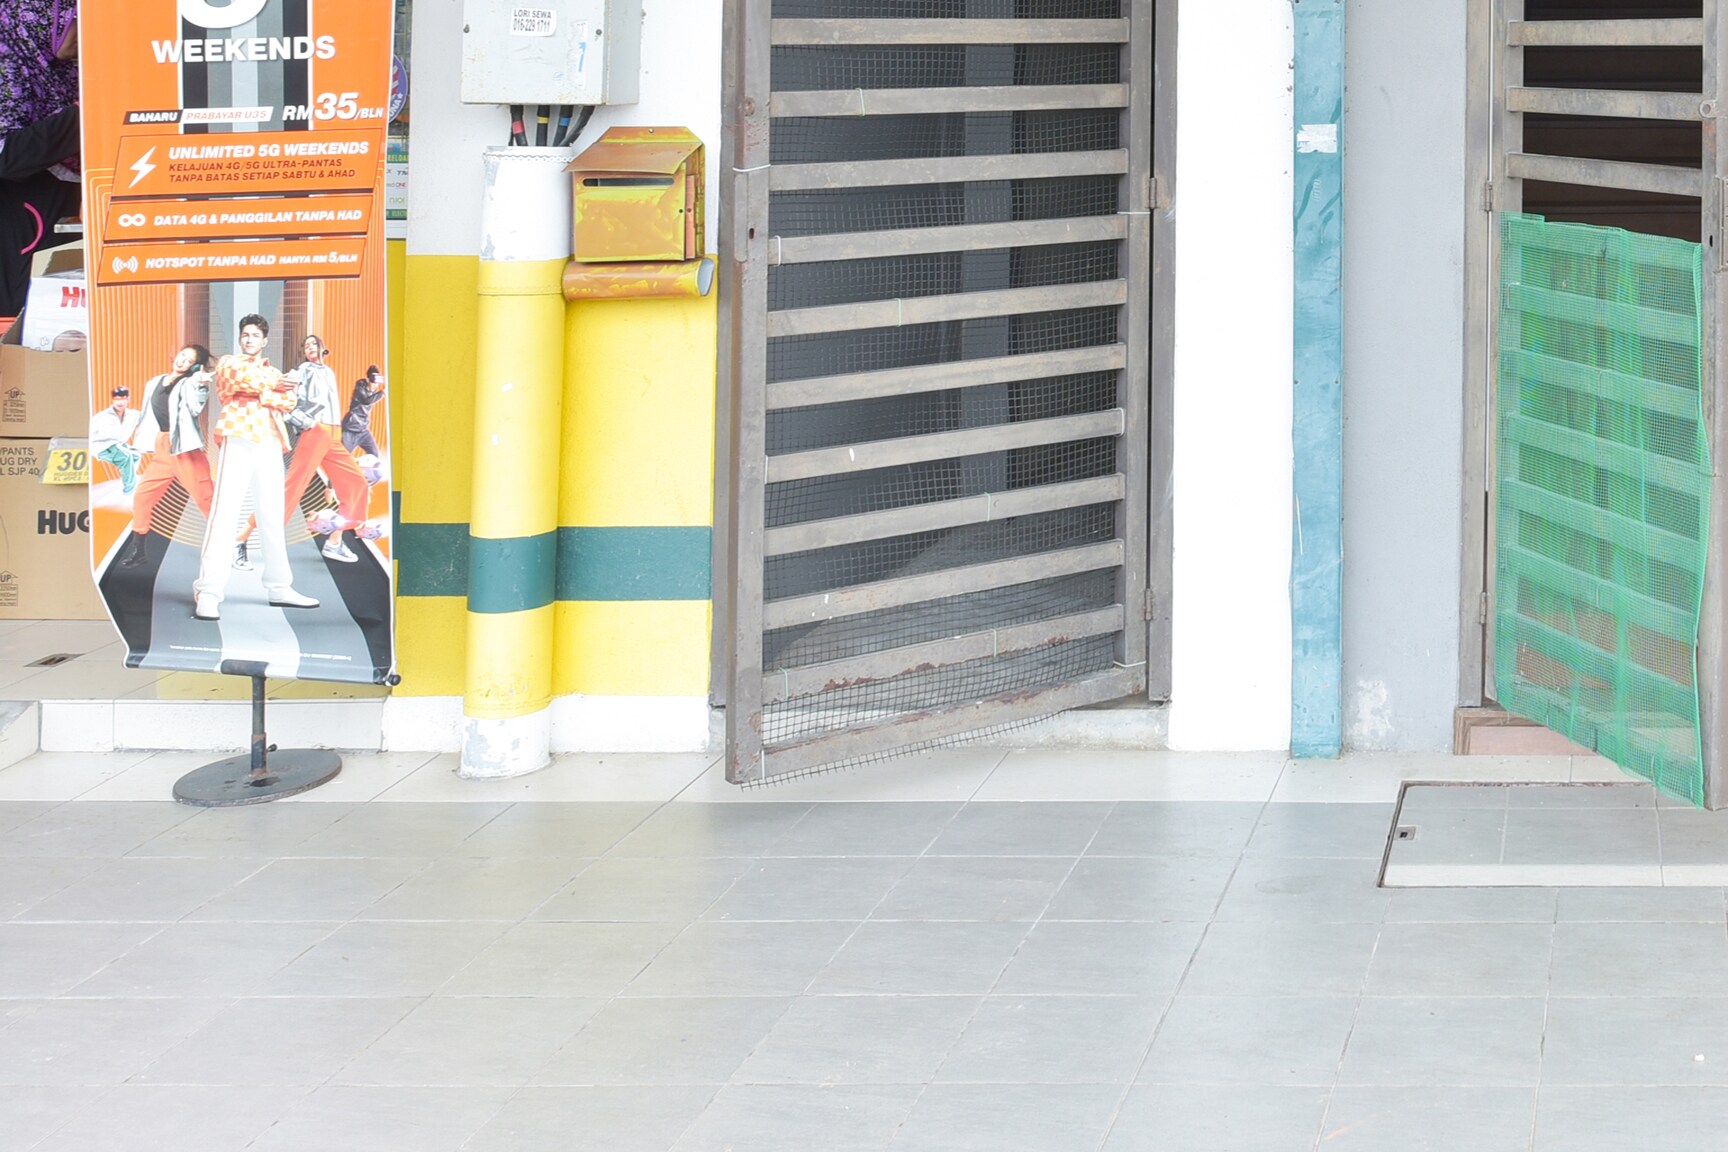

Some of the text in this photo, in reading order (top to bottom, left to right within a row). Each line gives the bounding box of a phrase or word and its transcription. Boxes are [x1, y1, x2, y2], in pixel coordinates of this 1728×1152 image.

[513, 9, 552, 19] LORI SEWA
[151, 35, 336, 63] WEEKENDS
[129, 109, 267, 123] BAHARU PRABAYAR U35
[169, 141, 369, 160] UNLIMITED 5G WEEKENDS
[169, 158, 342, 171] KELAJUAN 4G/5G ULTRA-PANTAS
[169, 169, 356, 183] TANPA BATAS SETIAP SABTU & AHAD
[153, 209, 362, 226] DATA 4G & PANGGILAN TANPA HAD
[145, 256, 205, 268] HOTSPOT
[207, 255, 247, 267] TANPA
[249, 254, 276, 265] HAD
[279, 255, 310, 264] HANYA
[10, 390, 20, 399] UP
[0, 447, 34, 456] PANTS
[18, 457, 37, 465] DRY
[57, 451, 89, 472] 30
[8, 467, 26, 475] SJP
